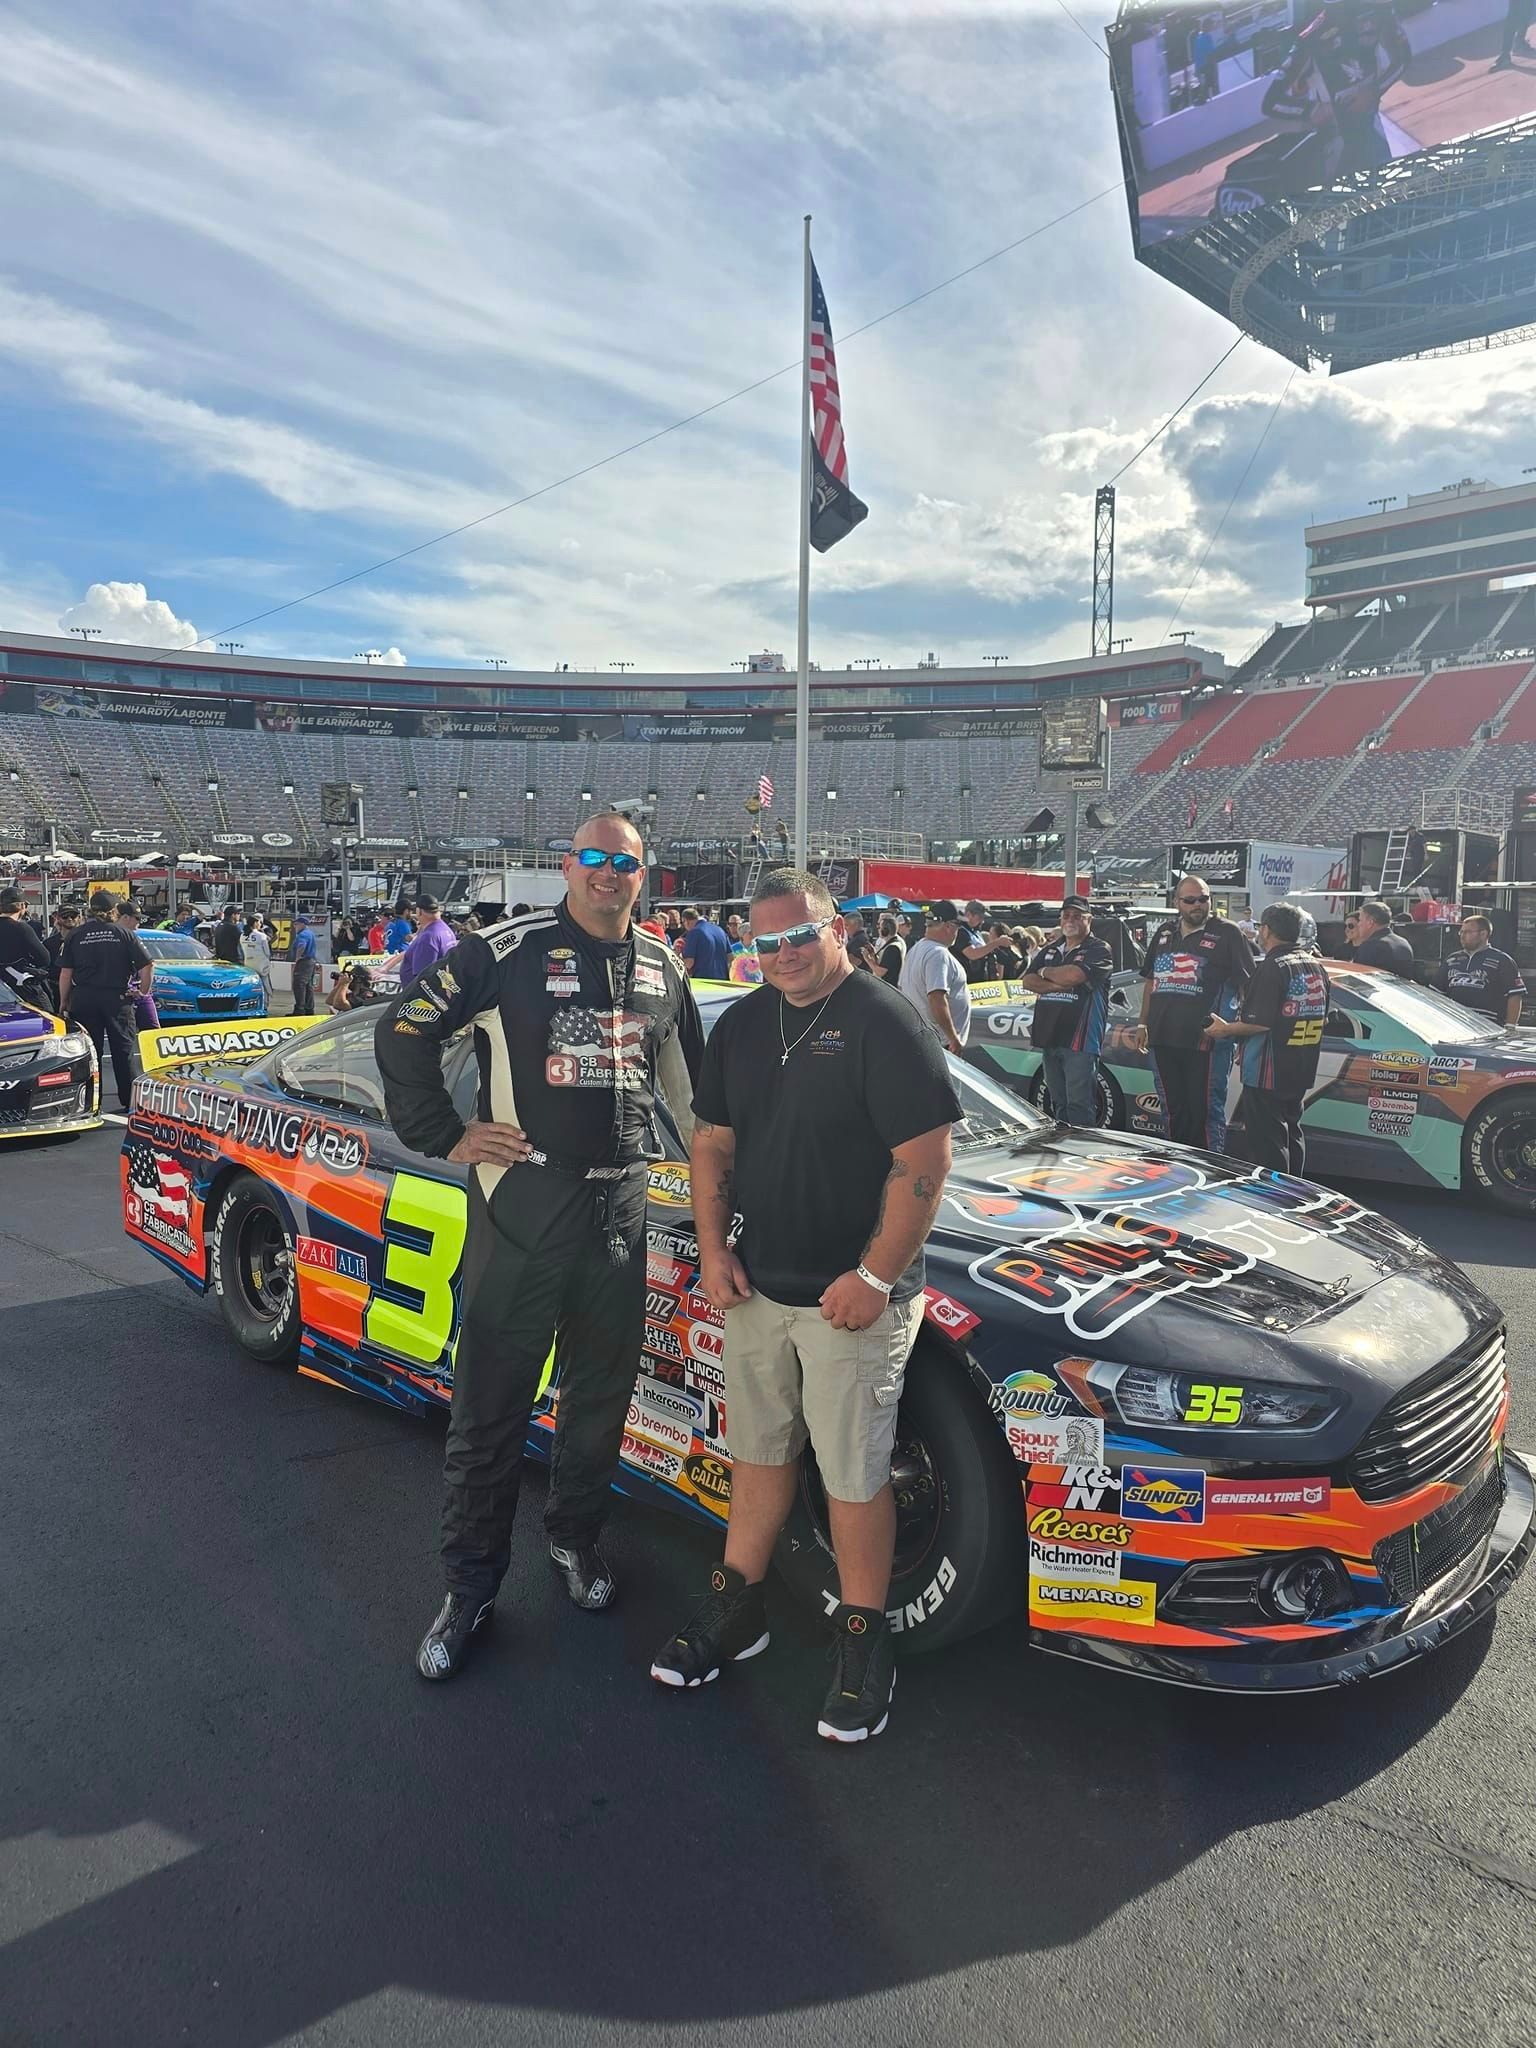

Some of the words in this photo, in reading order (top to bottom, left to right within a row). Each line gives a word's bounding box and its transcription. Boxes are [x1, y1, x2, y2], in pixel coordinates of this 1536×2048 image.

[99, 703, 227, 720] EARNHARDT/LABONTE
[1122, 706, 1145, 718] FOOD
[1159, 702, 1179, 714] CITY
[189, 718, 213, 726] CLASH
[286, 715, 314, 726] DALE
[316, 717, 381, 728] EARNHARDT
[473, 723, 509, 733] BUSCH
[512, 725, 560, 734] WEEKEND
[643, 726, 668, 736] TONY
[670, 727, 708, 735] HELMET
[710, 726, 746, 735] THROW
[821, 724, 869, 733] COLOSSUS
[871, 724, 885, 733] TV
[962, 721, 1001, 730] BATTLE
[1001, 720, 1016, 729] AT
[1182, 850, 1239, 871] Hendrick
[1258, 853, 1295, 877] Hendrick
[1263, 873, 1291, 886] Cars.com
[495, 935, 517, 951] OMP
[969, 986, 1002, 1001] ENARDS
[398, 1003, 441, 1022] Bounty
[1286, 1019, 1325, 1046] 35
[580, 1056, 598, 1067] CB
[1371, 1052, 1426, 1065] MENARDS
[1430, 1057, 1460, 1069] ARCA
[1371, 1069, 1400, 1082] Holley
[1096, 1072, 1114, 1129] GENERA
[1383, 1089, 1419, 1100] ILMOR
[1381, 1100, 1415, 1112] brembo
[1370, 1111, 1413, 1124] COMETIC
[154, 1126, 176, 1141] AND
[183, 1135, 201, 1148] AIR
[1471, 1113, 1498, 1188] GENERAL
[647, 1170, 691, 1196] ENAR
[143, 1200, 156, 1215] CB
[143, 1212, 198, 1252] FABRICATING
[213, 1191, 238, 1296] GENERAL
[646, 1230, 700, 1258] OMETIC
[299, 1242, 335, 1268] ZAKI
[338, 1254, 360, 1277] ALI
[366, 1172, 468, 1363] 3
[269, 1232, 295, 1342] GENERAL
[646, 1292, 675, 1318] OTZ
[647, 1325, 679, 1346] RTER
[687, 1358, 726, 1385] LINCOL
[642, 1384, 696, 1420] Intercomp
[988, 1382, 1071, 1421] Bounty
[1183, 1384, 1245, 1424] 35
[641, 1412, 688, 1445] brembo
[1008, 1426, 1060, 1448] Sioux
[704, 1439, 734, 1461] shock
[1011, 1443, 1055, 1464] Chief
[642, 1458, 672, 1477] CAMS
[1060, 1464, 1123, 1491] K&
[1127, 1487, 1201, 1507] SUNOCO
[1211, 1492, 1274, 1504] GENERAL
[1274, 1491, 1302, 1503] TIRE
[1029, 1507, 1134, 1546] Reese's
[1030, 1541, 1117, 1569] Richmond
[1042, 1562, 1053, 1570] The
[1053, 1564, 1071, 1574] Water
[1071, 1565, 1092, 1574] Heater
[1092, 1566, 1116, 1577] Experts
[590, 1579, 608, 1600] OMP
[1038, 1585, 1144, 1608] MENARDS
[430, 1643, 449, 1670] OMP
